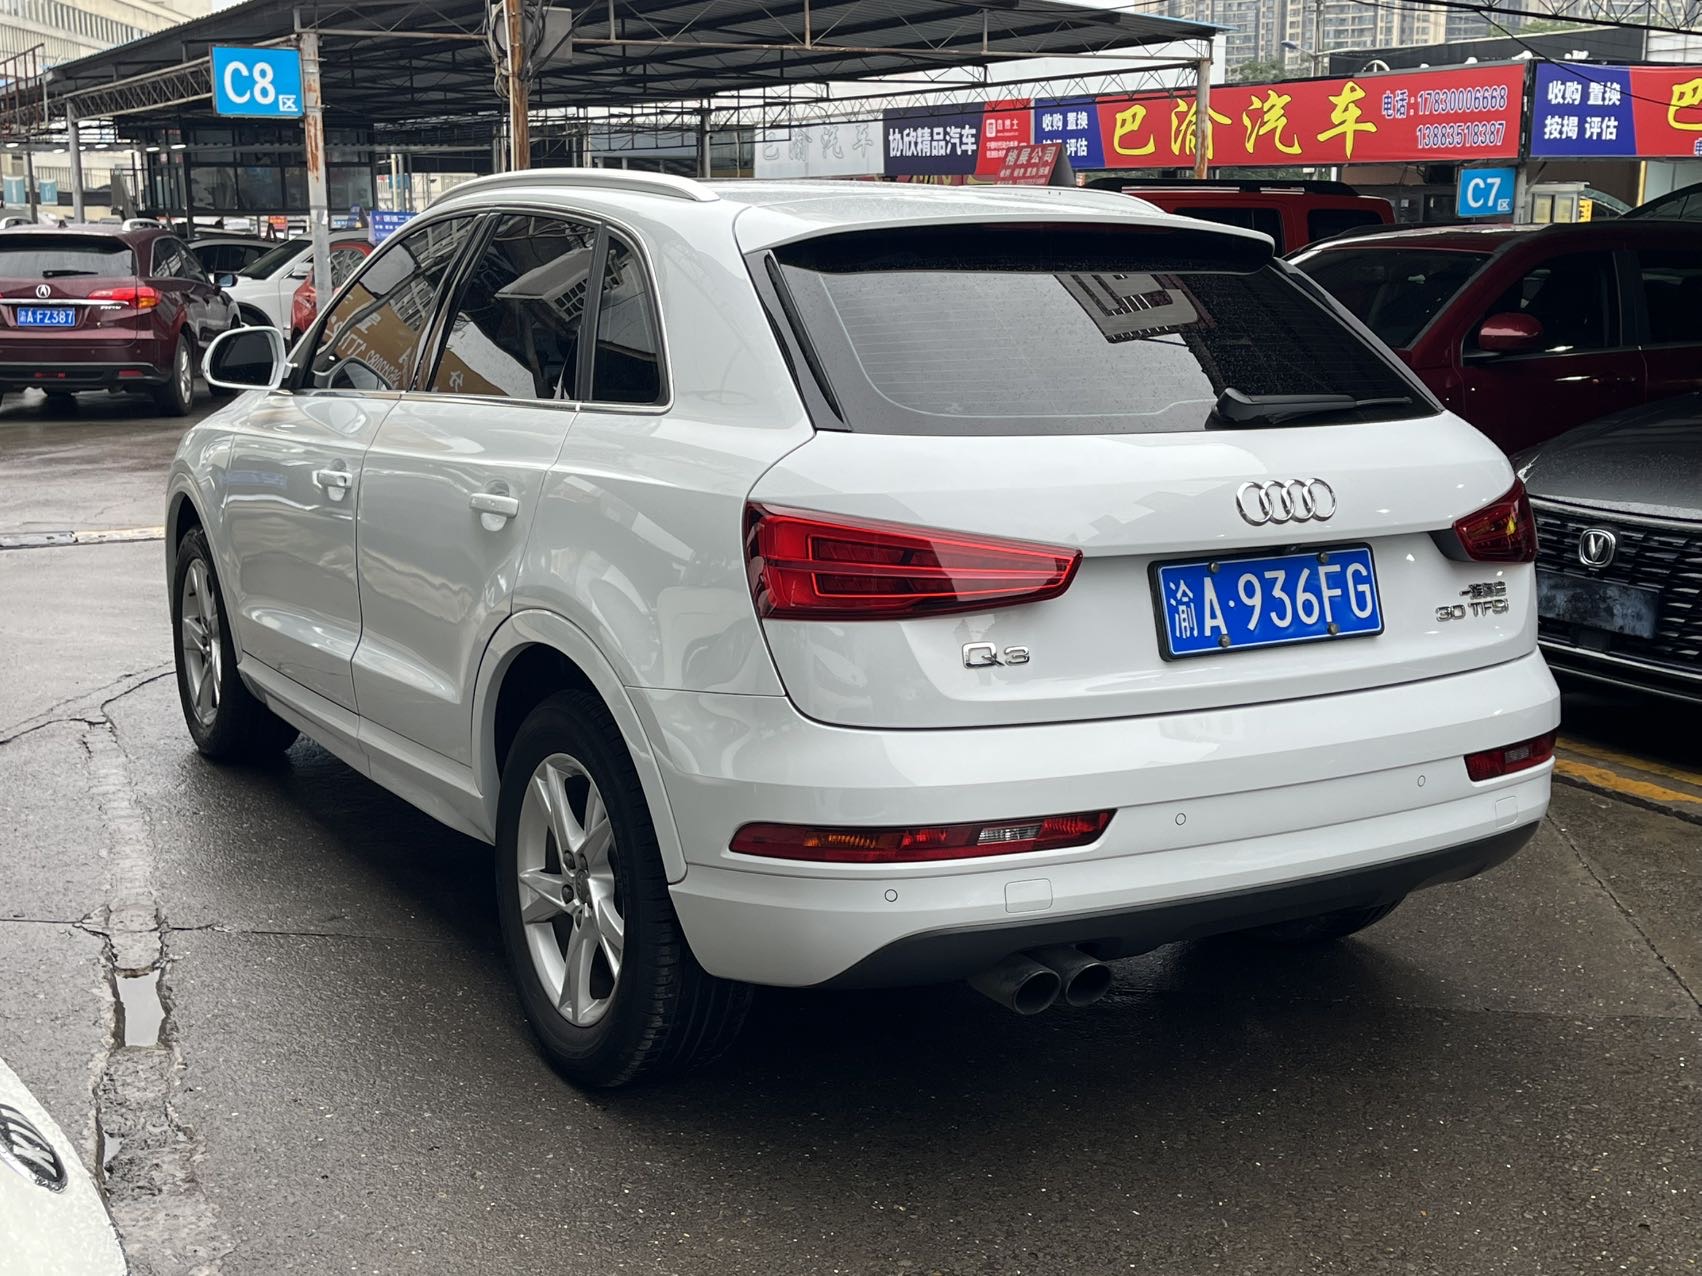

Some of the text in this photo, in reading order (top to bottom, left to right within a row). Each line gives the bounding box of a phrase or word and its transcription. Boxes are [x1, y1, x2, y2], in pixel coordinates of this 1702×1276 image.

[1547, 80, 1621, 106] 收购 置换
[1042, 111, 1088, 131] 收购 置换
[1544, 115, 1619, 141] 按揭 评估
[888, 124, 977, 158] 协欣精品汽车
[1066, 138, 1088, 156] 评估
[1416, 121, 1506, 149] 13883518387
[962, 641, 1030, 669] Q3
